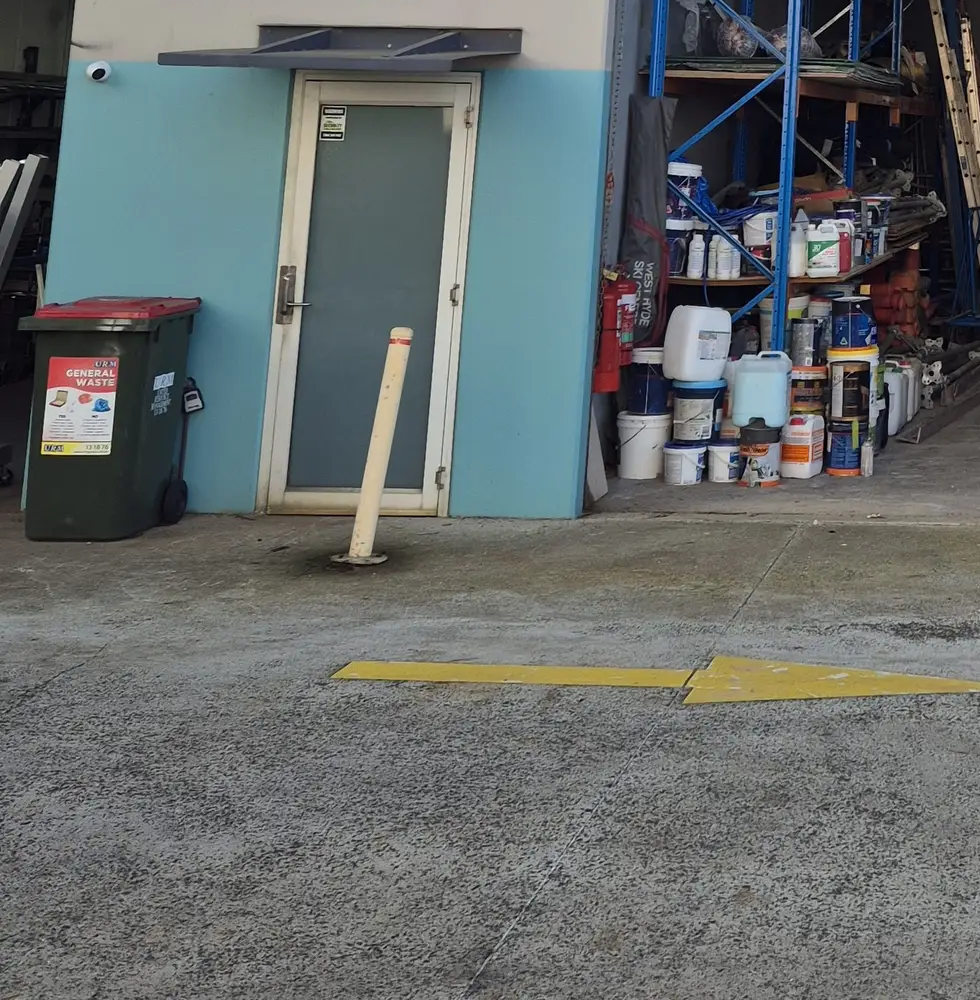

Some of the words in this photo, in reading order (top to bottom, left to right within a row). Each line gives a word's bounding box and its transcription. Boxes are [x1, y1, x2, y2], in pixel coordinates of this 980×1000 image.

[633, 260, 645, 280] SKI
[643, 262, 655, 293] WEST
[639, 297, 653, 328] HYDE
[94, 360, 117, 369] URM
[66, 369, 116, 378] GENERAL
[76, 378, 115, 387] WASTE
